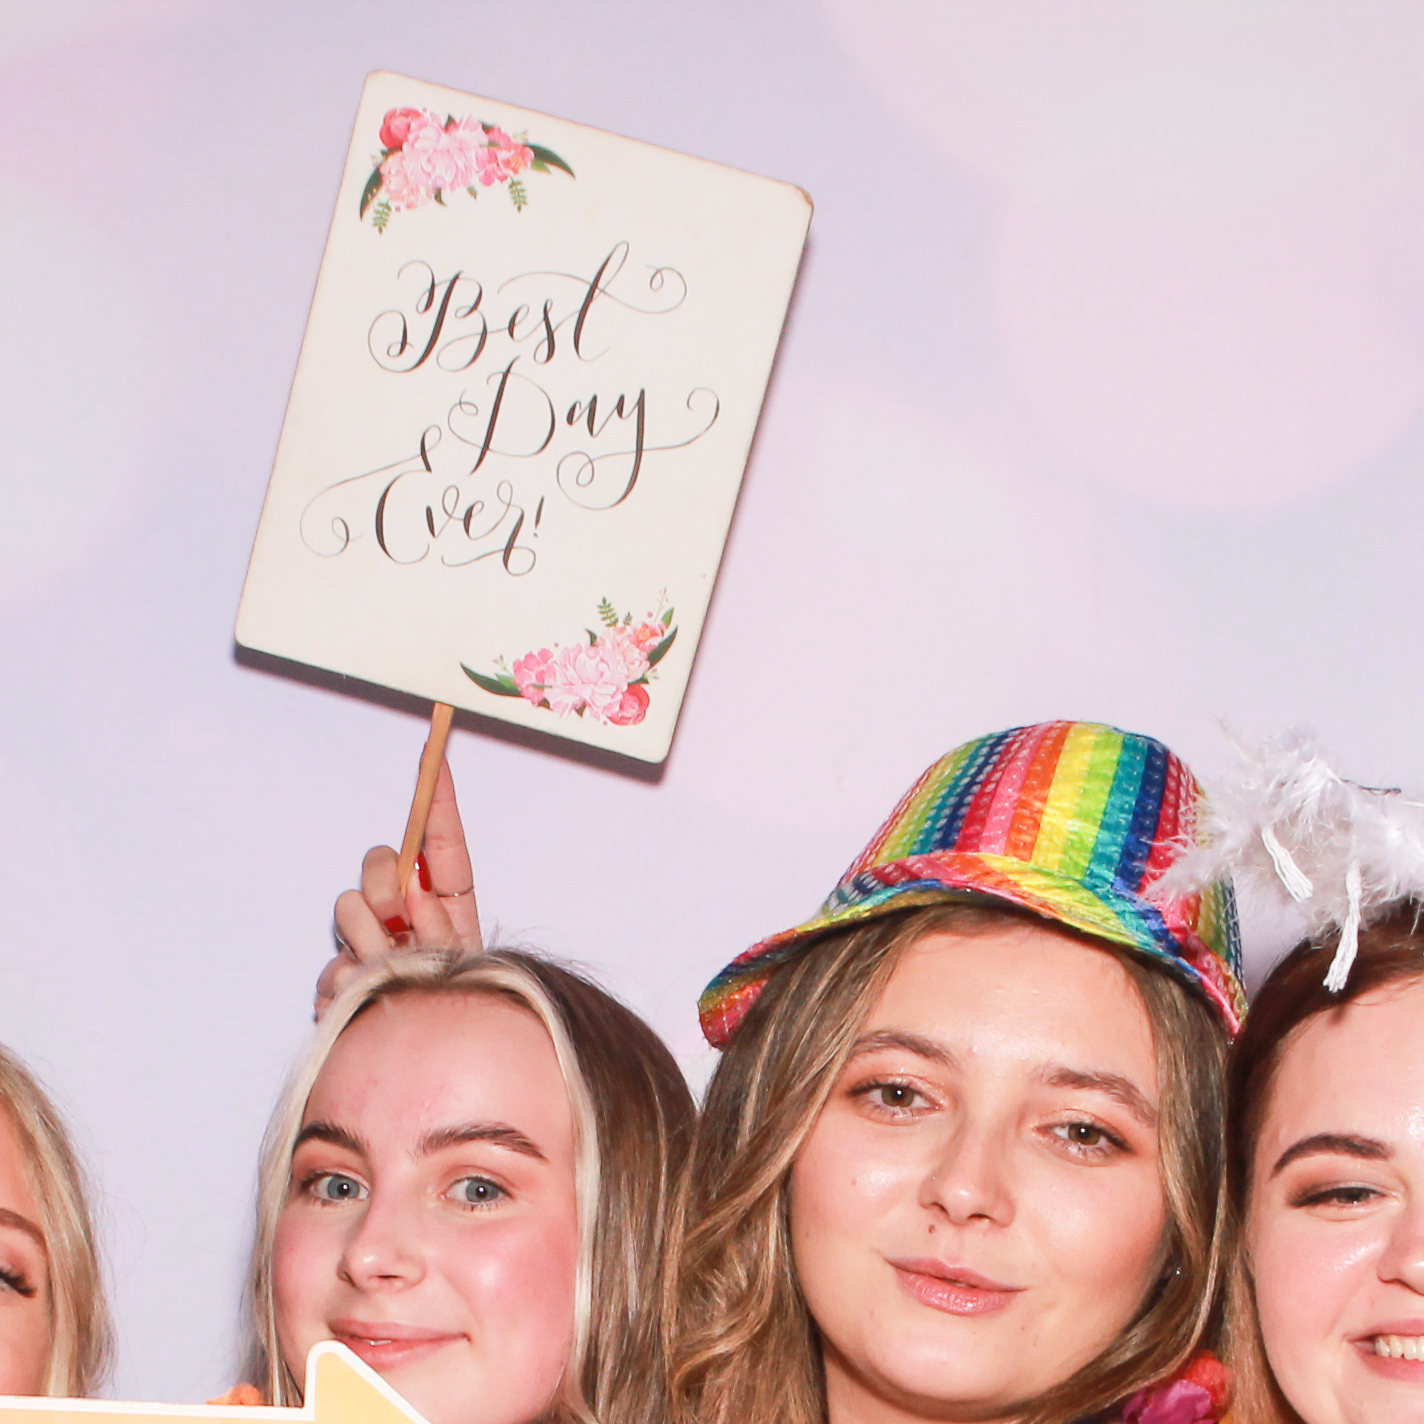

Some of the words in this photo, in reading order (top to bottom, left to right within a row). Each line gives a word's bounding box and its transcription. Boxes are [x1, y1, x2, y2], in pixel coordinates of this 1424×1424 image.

[368, 241, 687, 373] Best
[300, 424, 545, 577] Ever!
[447, 355, 720, 510] Day
